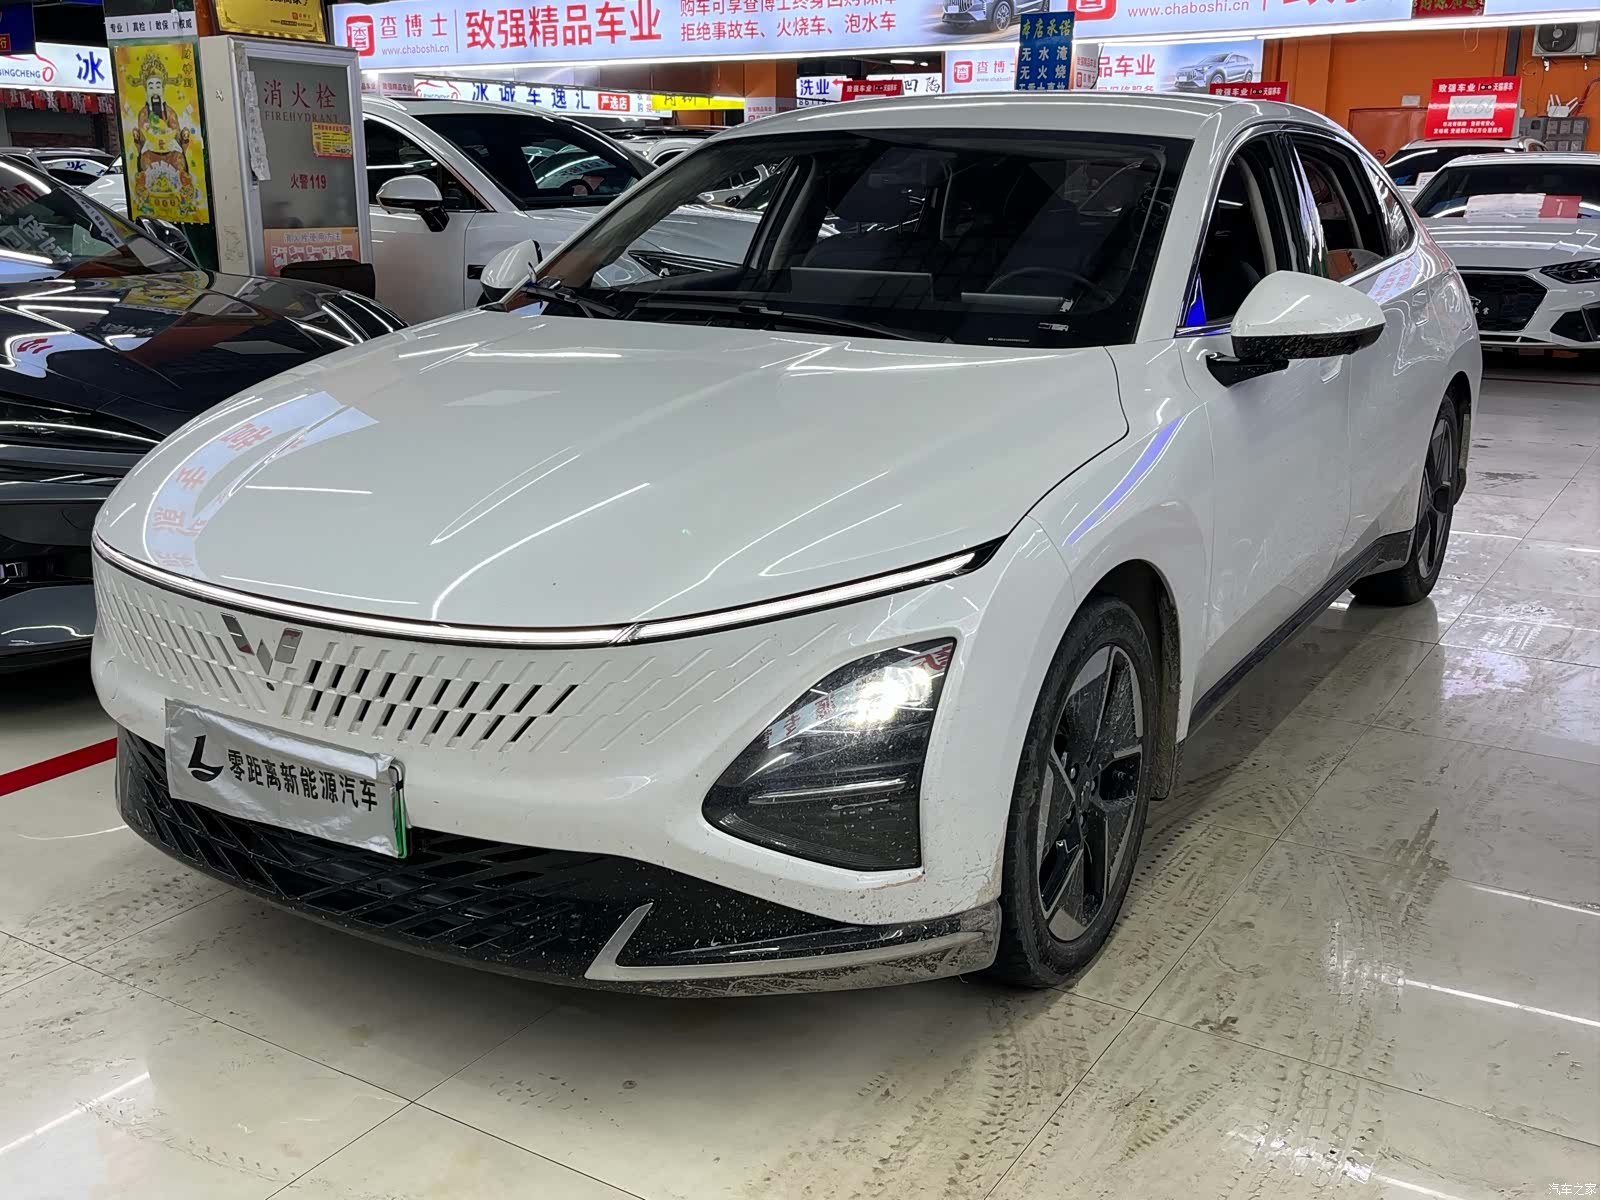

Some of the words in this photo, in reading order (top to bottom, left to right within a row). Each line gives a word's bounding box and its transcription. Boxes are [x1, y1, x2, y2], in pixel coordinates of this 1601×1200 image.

[680, 0, 897, 17] 购车可享查博士终身
[1127, 0, 1249, 18] www.chaboshi.cn
[380, 12, 448, 39] 查博士
[465, 0, 662, 49] 致强精品车业
[680, 10, 897, 42] 拒绝事故车、火烧车、泡水车
[1021, 18, 1072, 40] 本店承诺
[381, 43, 450, 56] www.chaboshi.cn
[1021, 45, 1068, 62] 无水淹
[75, 51, 106, 84] 冰
[1019, 64, 1067, 80] 无火烧
[1098, 54, 1156, 78] 品车业
[264, 79, 337, 108] 消火栓
[800, 78, 830, 96] 洗业
[600, 92, 628, 111] 严选店
[290, 173, 327, 190] 火警119
[227, 748, 379, 812] 零距离新能源汽车
